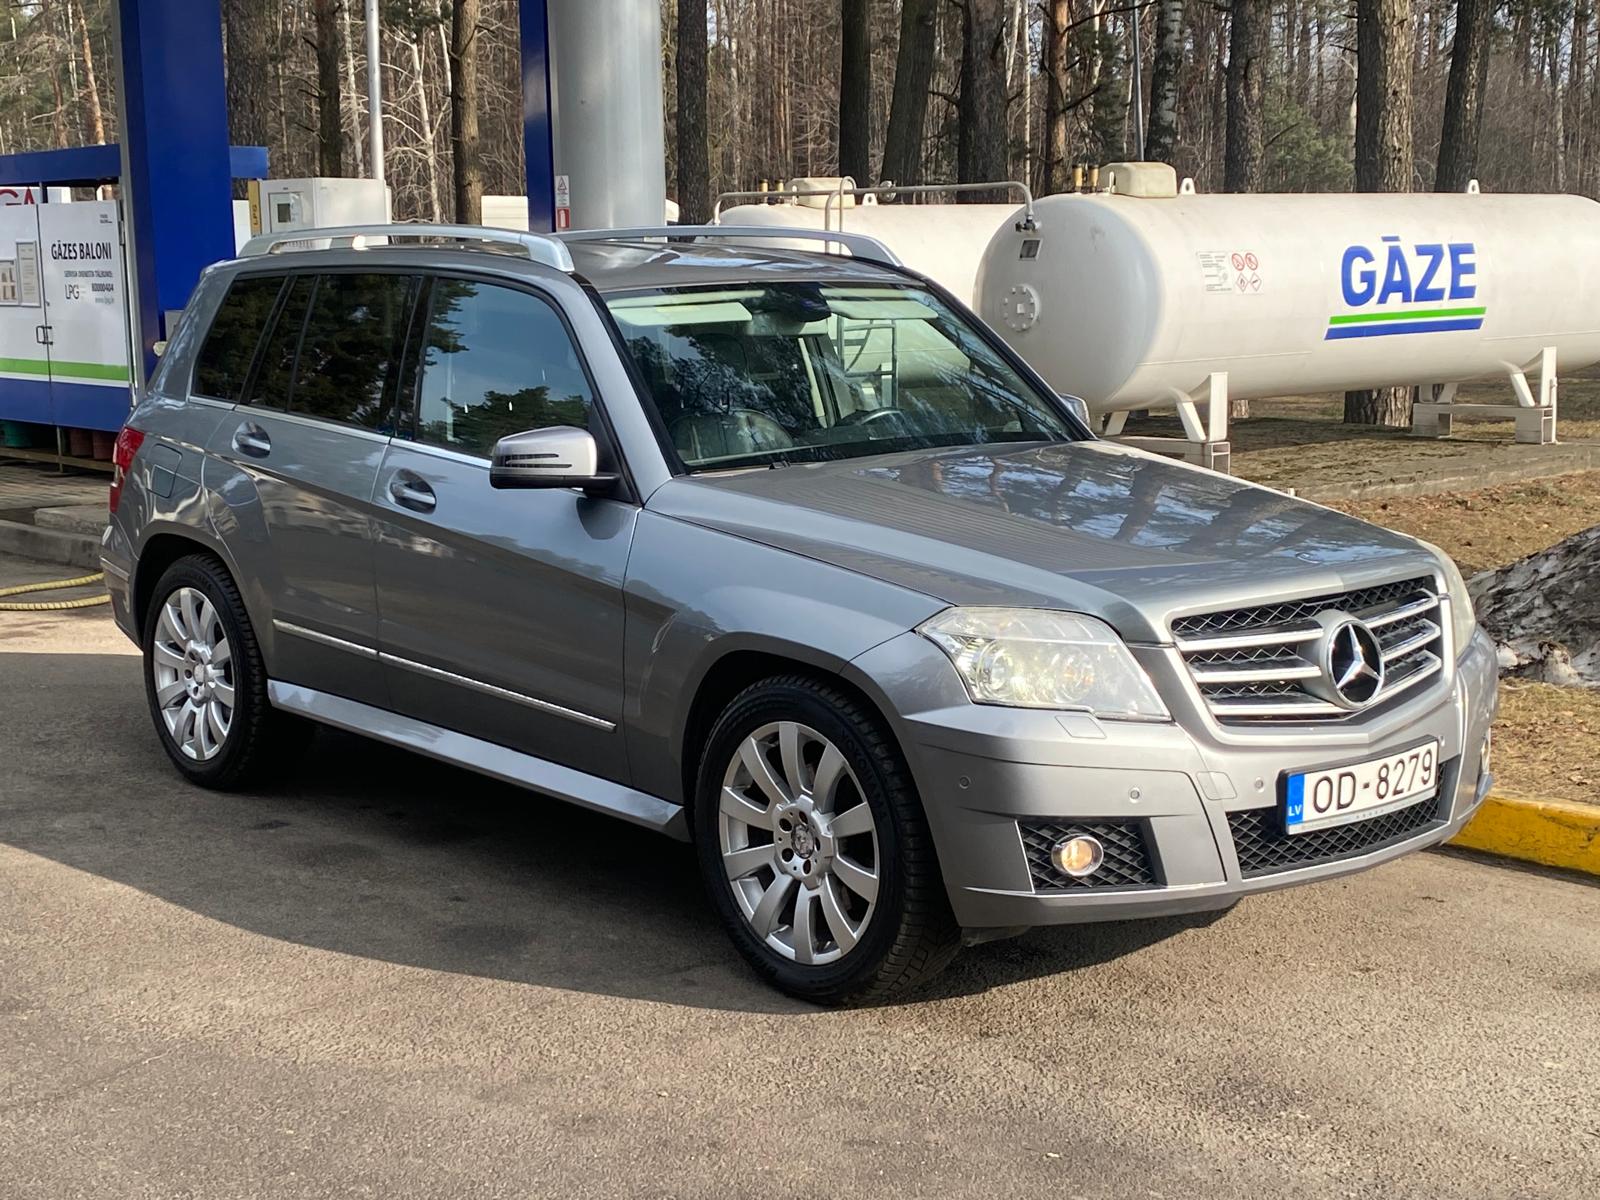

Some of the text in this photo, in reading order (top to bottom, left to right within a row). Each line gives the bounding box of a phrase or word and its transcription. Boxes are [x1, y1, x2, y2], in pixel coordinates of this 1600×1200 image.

[51, 239, 112, 260] GĀZES BALONI
[1341, 236, 1477, 306] GĀZE
[64, 283, 80, 300] LPG
[1312, 747, 1433, 813] OD-8279
[1288, 804, 1302, 818] LV
